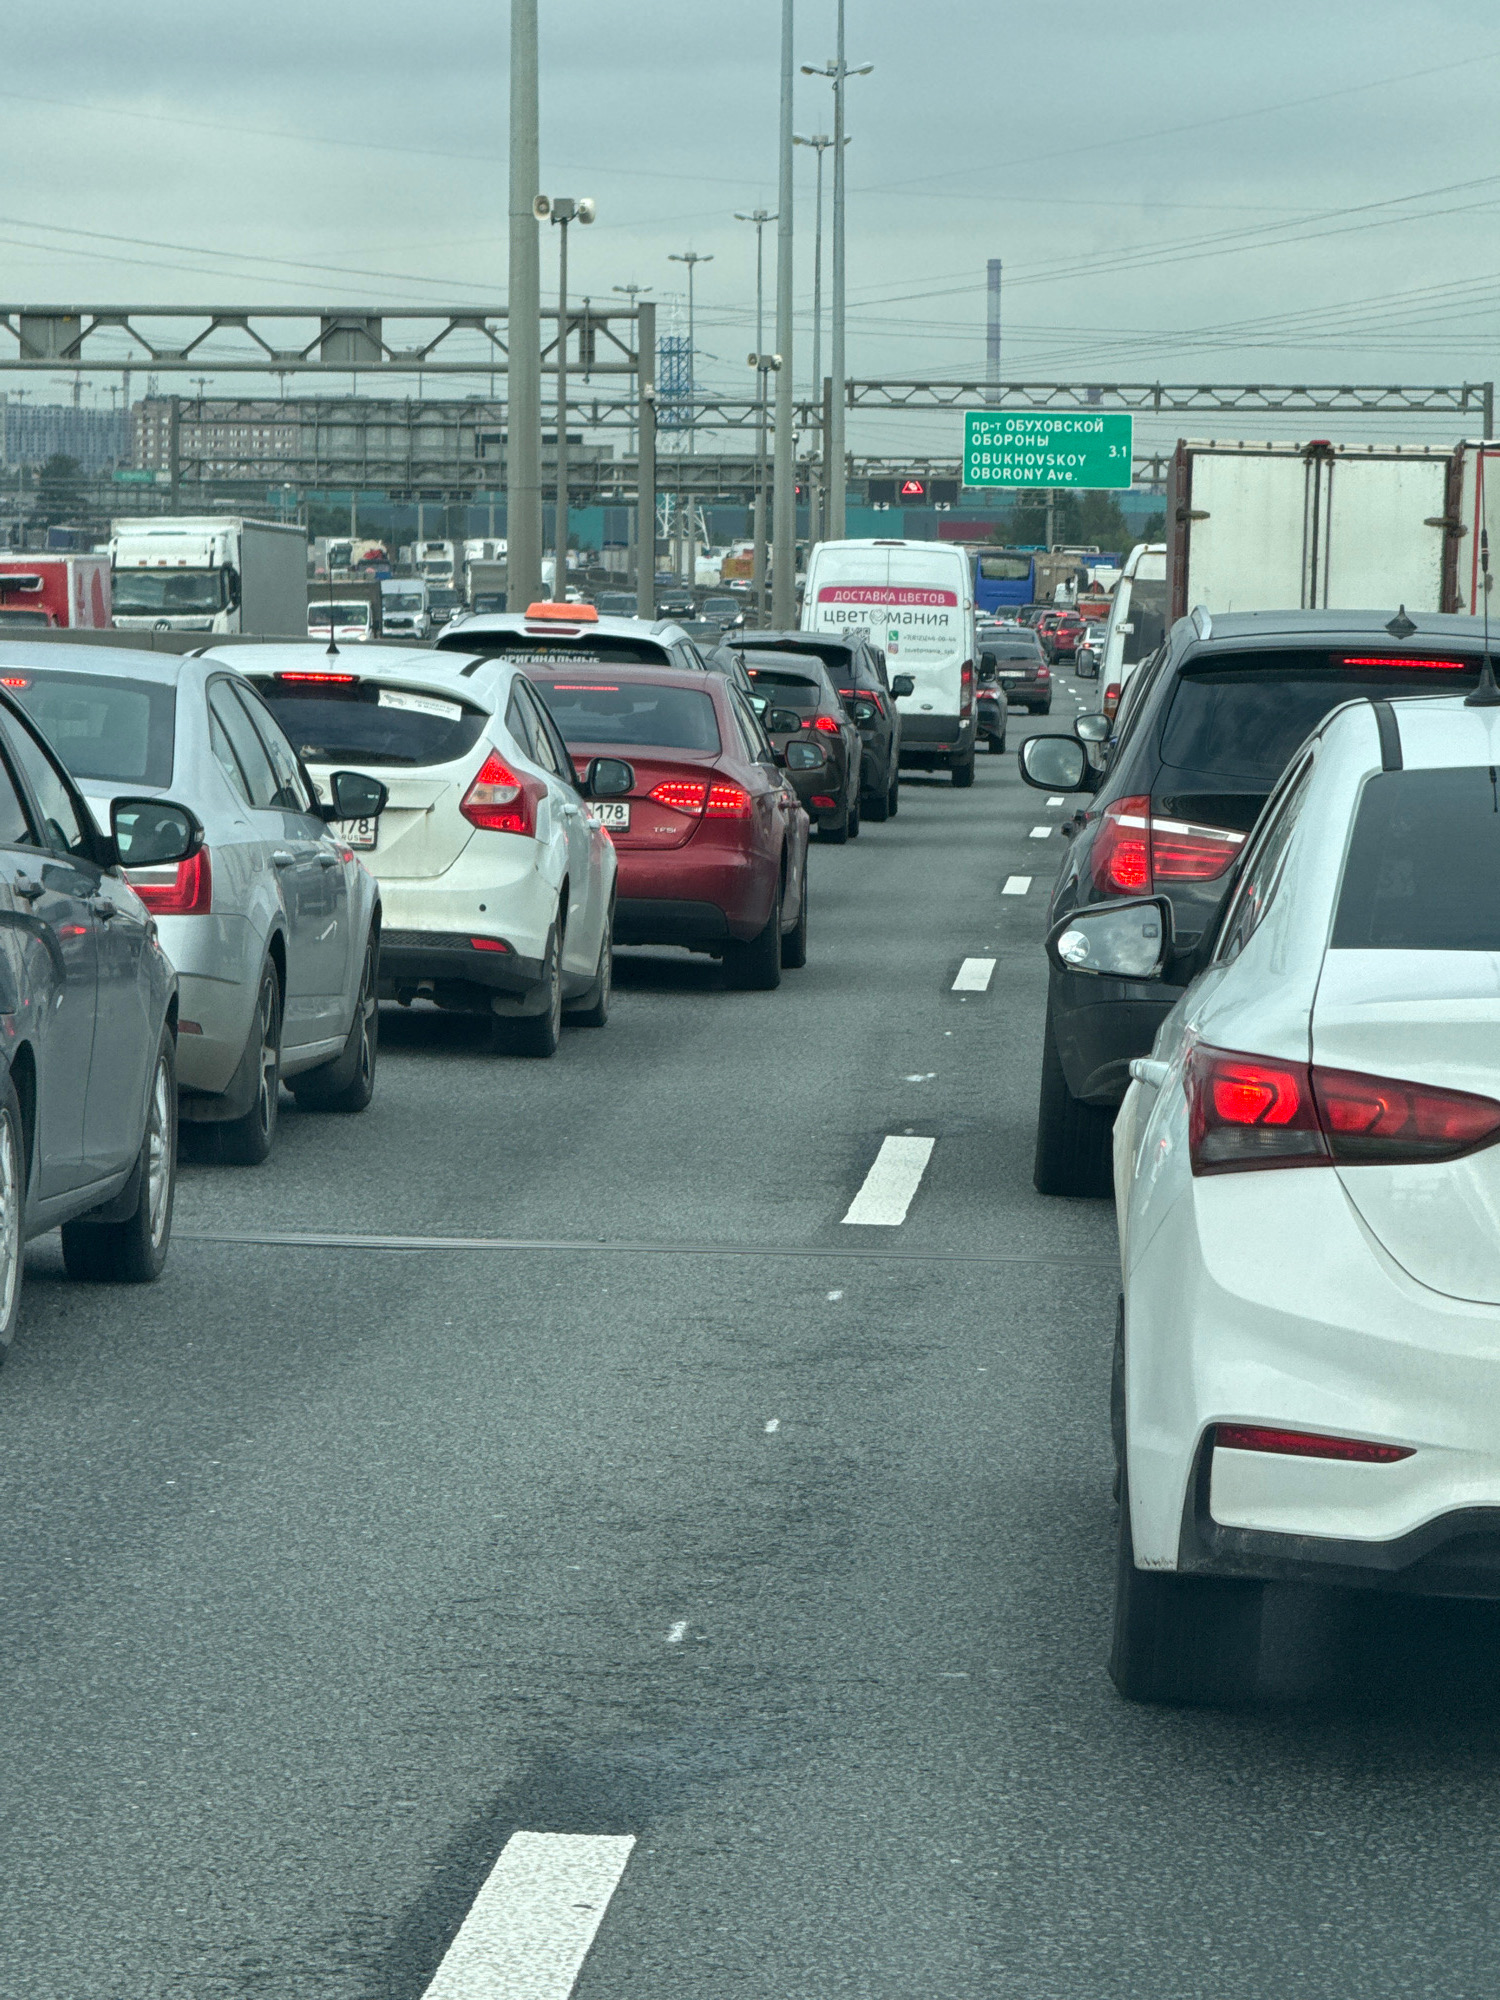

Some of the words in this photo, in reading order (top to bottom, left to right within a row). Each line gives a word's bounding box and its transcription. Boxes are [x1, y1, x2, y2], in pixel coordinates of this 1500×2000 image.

[972, 421, 1001, 433] пр-т
[1006, 418, 1104, 433] ОБУХОВСКОЙ
[972, 434, 1049, 446] ОБОРОНЫ
[1108, 445, 1127, 457] 3.1
[971, 453, 1086, 466] OBUKHOVSKOY
[971, 467, 1044, 480] OBORONY
[1047, 471, 1078, 481] Ave.
[833, 590, 896, 602] ДОСТАВКА
[898, 593, 946, 604] ЦВЕТОВ
[595, 804, 624, 819] 178
